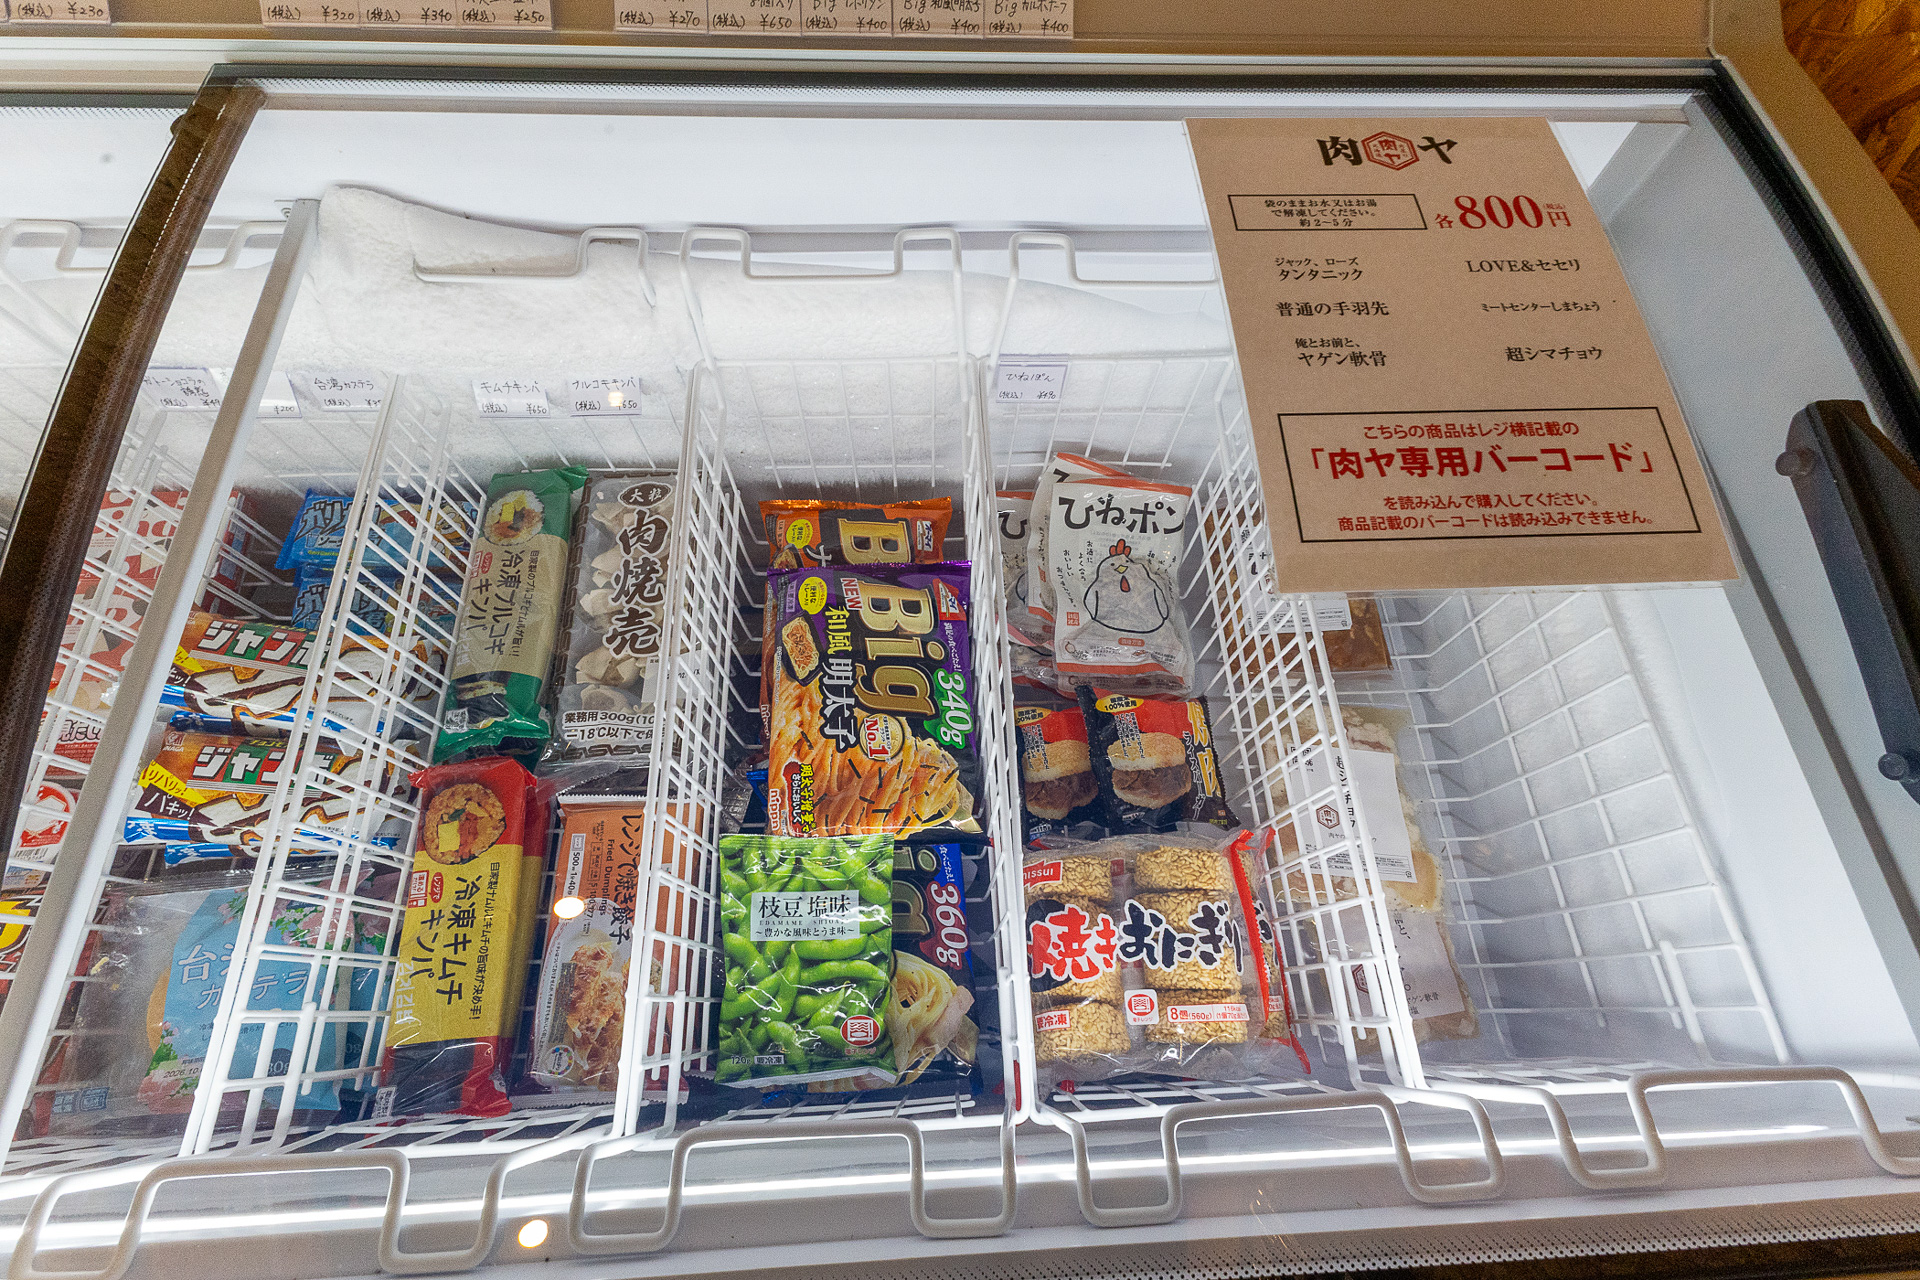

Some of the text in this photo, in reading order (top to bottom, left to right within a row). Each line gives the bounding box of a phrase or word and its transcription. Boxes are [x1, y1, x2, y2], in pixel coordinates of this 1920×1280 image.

[67, 1, 104, 19] ¥230
[321, 6, 355, 21] ¥320
[420, 7, 452, 22] ¥340
[514, 8, 545, 22] ¥250
[619, 10, 701, 28] (税込) ¥270
[712, 13, 793, 32] (税込) ¥650
[806, 14, 888, 31] (税込) ¥400
[899, 16, 980, 34] (税込) ¥400
[1041, 18, 1069, 36] ¥400
[1316, 135, 1363, 166] 肉
[1271, 208, 1377, 217] で解凍してください。
[1279, 268, 1363, 281] タンタニック
[1465, 258, 1580, 273] LOVE&セセリ
[1276, 301, 1390, 317] 普通の手羽先
[1481, 301, 1600, 312] ミートセンターしまちょう
[1295, 337, 1361, 348] 俺とお前と、
[1504, 346, 1603, 362] 超シマチョウ
[1298, 351, 1387, 367] ヤゲン軟骨
[526, 403, 548, 415] ¥650
[1363, 421, 1580, 440] こちらの商品はレジ横記載の
[1311, 442, 1653, 480] 「肉ヤ専用バーコード」
[629, 487, 662, 503] 大粒
[1383, 492, 1598, 510] を読み込んで購入してください。
[1058, 494, 1184, 535] ひねポン
[1337, 510, 1653, 532] 商品記載のバーコードは読み込みできません。
[1063, 549, 1074, 577] おいしい
[604, 508, 669, 657] 肉焼売
[841, 578, 863, 610] NEW
[465, 578, 493, 631] キンパ
[484, 549, 526, 656] 冷凍プルコギ
[853, 580, 946, 717] Big
[823, 606, 855, 750] 和風明太子
[937, 671, 973, 745] 340g
[863, 717, 889, 758] No.1
[769, 788, 781, 831] nippn
[791, 773, 802, 824] さらにおいしく
[599, 839, 615, 917] Fried Dumplings
[609, 814, 643, 946] レンジで焼き餃子
[759, 893, 851, 919] 枝豆 塩味
[930, 882, 969, 967] 360g
[409, 909, 445, 979] キンパ
[436, 875, 483, 1006] 冷凍キムチ
[1028, 902, 1243, 980] 焼きおにぎり
[197, 970, 308, 1009] カテラ
